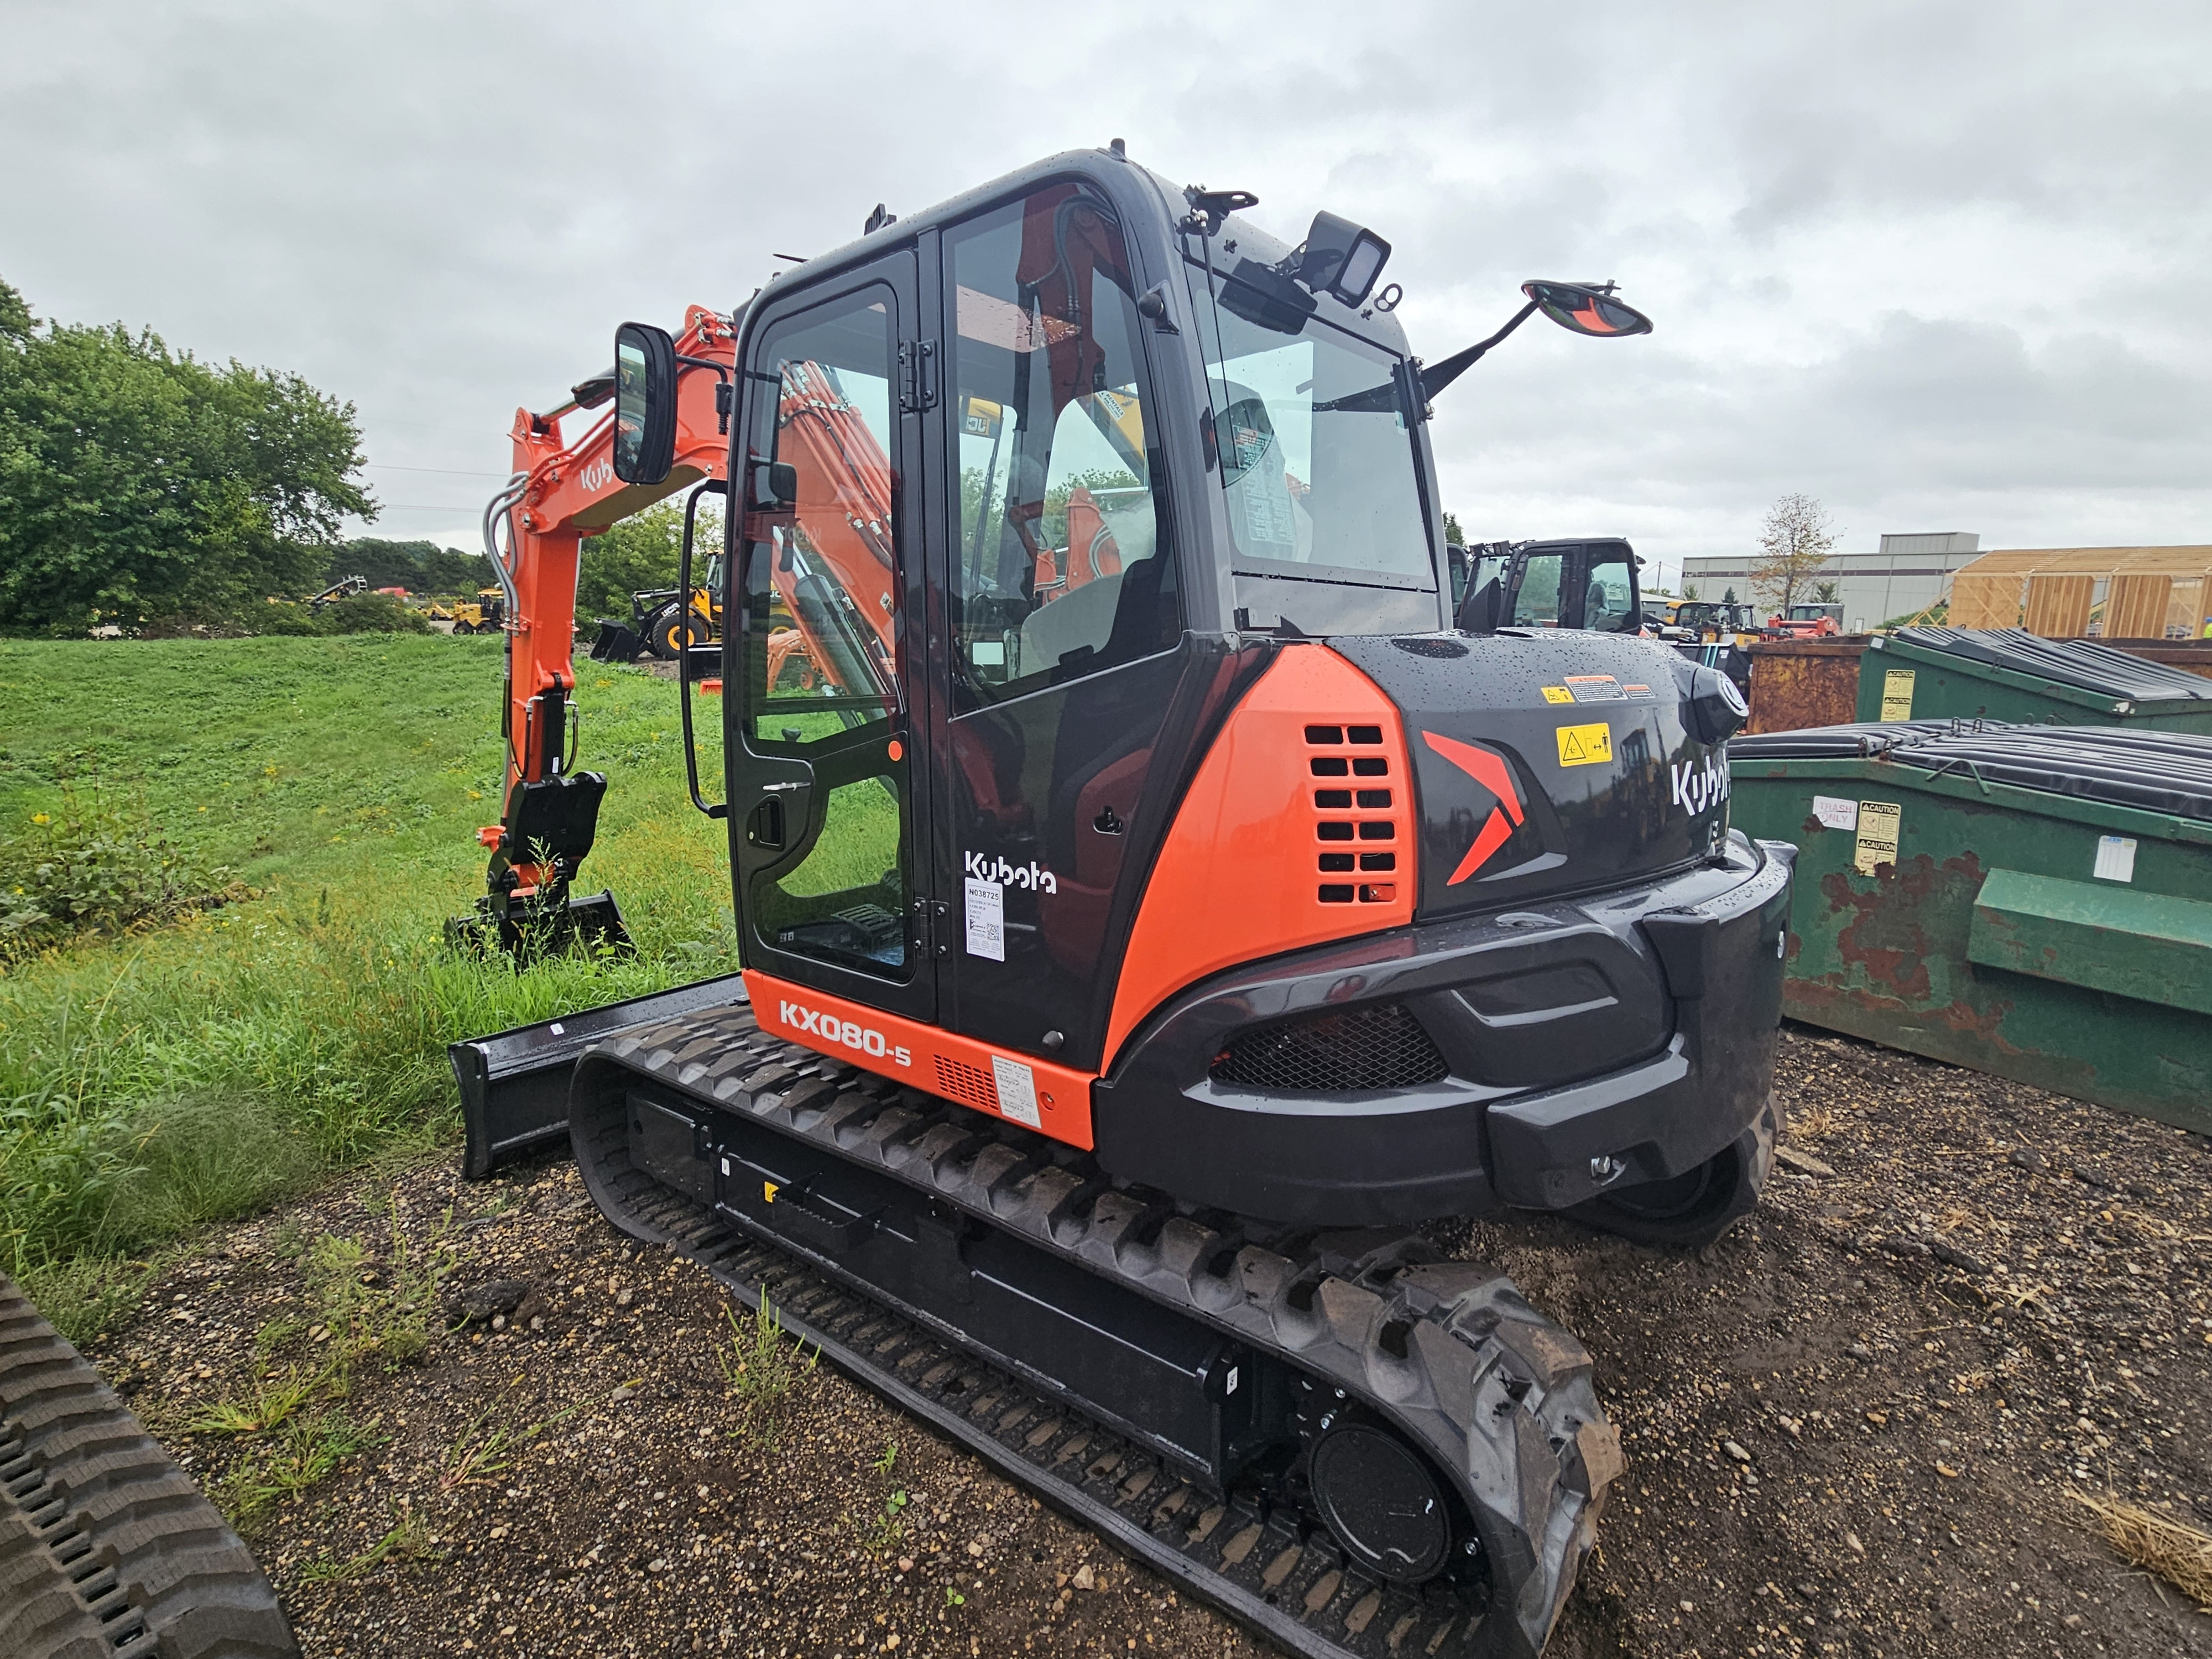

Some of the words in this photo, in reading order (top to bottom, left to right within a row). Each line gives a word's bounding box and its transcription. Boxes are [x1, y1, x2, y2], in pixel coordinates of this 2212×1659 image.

[1106, 394, 1124, 415] RENTALS
[580, 457, 612, 492] Kub
[1819, 802, 1852, 813] TRASH
[1869, 805, 1898, 814] CAUTION
[1822, 813, 1849, 823] ONLY
[1866, 841, 1895, 851] CAUTION
[965, 851, 1057, 894] Kubota
[969, 888, 999, 900] N038725
[780, 1000, 911, 1067] KX080-5
